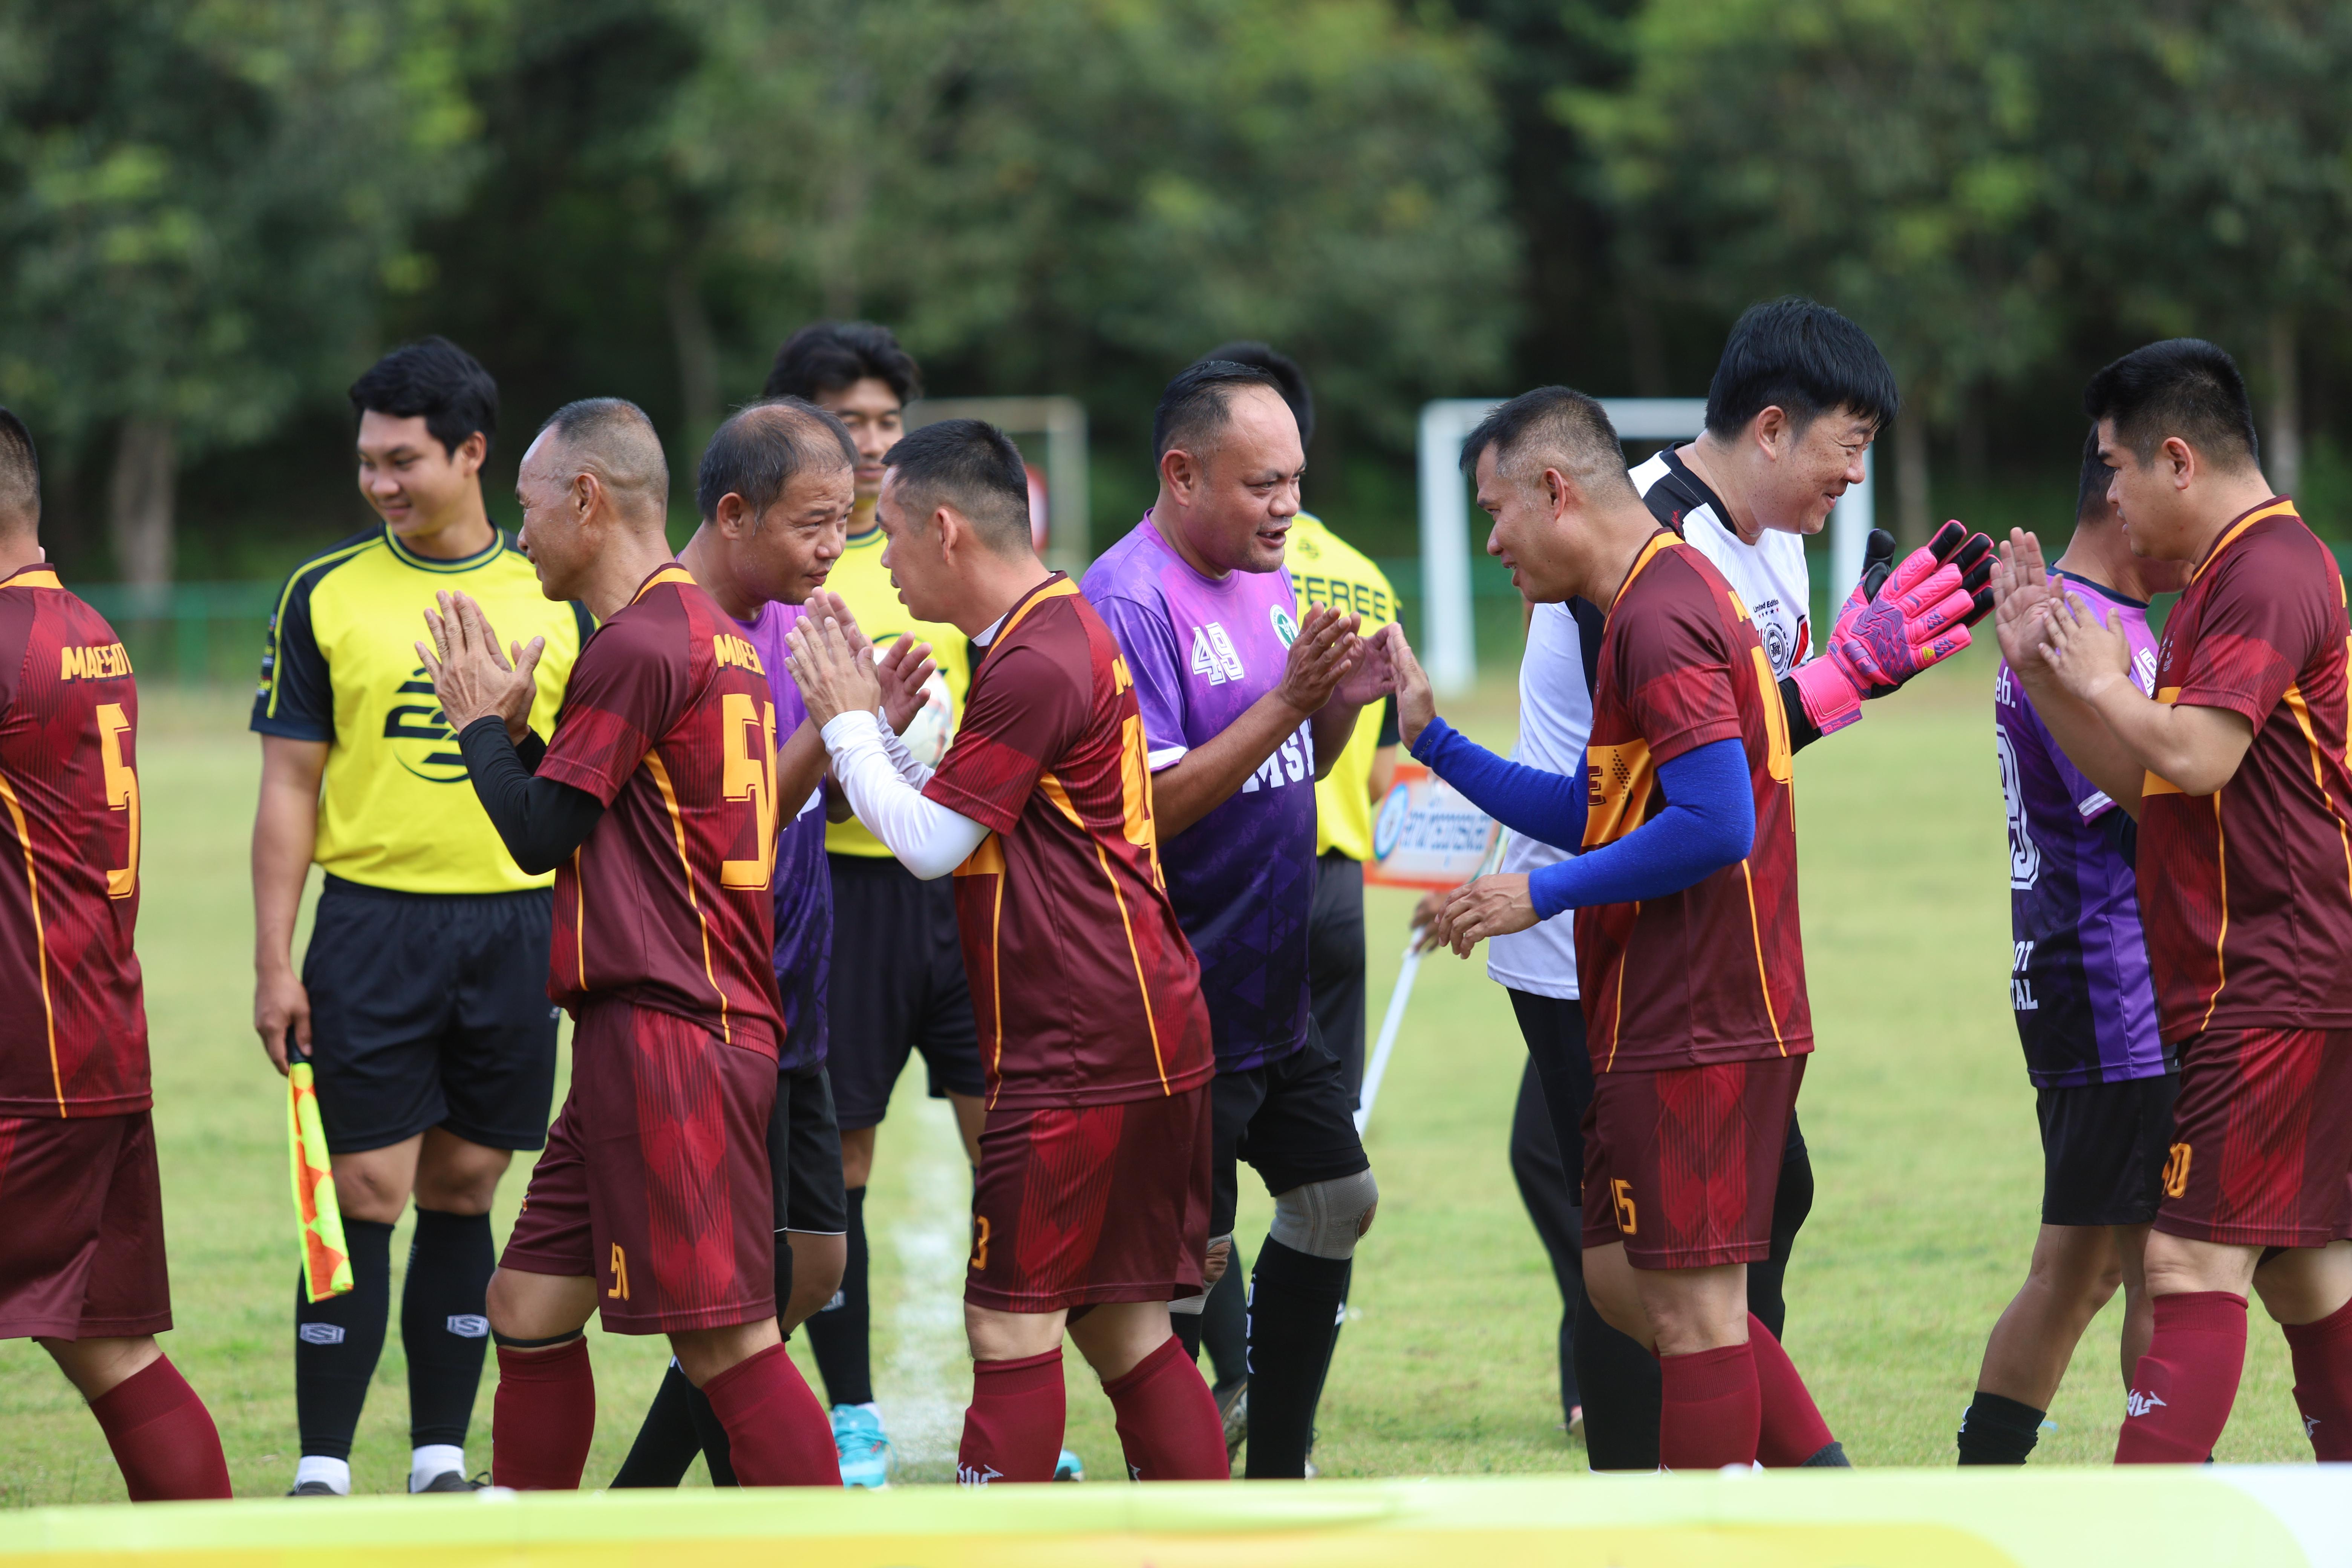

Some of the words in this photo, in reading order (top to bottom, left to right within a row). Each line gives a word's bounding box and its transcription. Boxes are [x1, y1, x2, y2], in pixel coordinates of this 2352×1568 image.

[1191, 622, 1244, 686] 49
[96, 703, 140, 900] 5
[2012, 940, 2034, 972] OT
